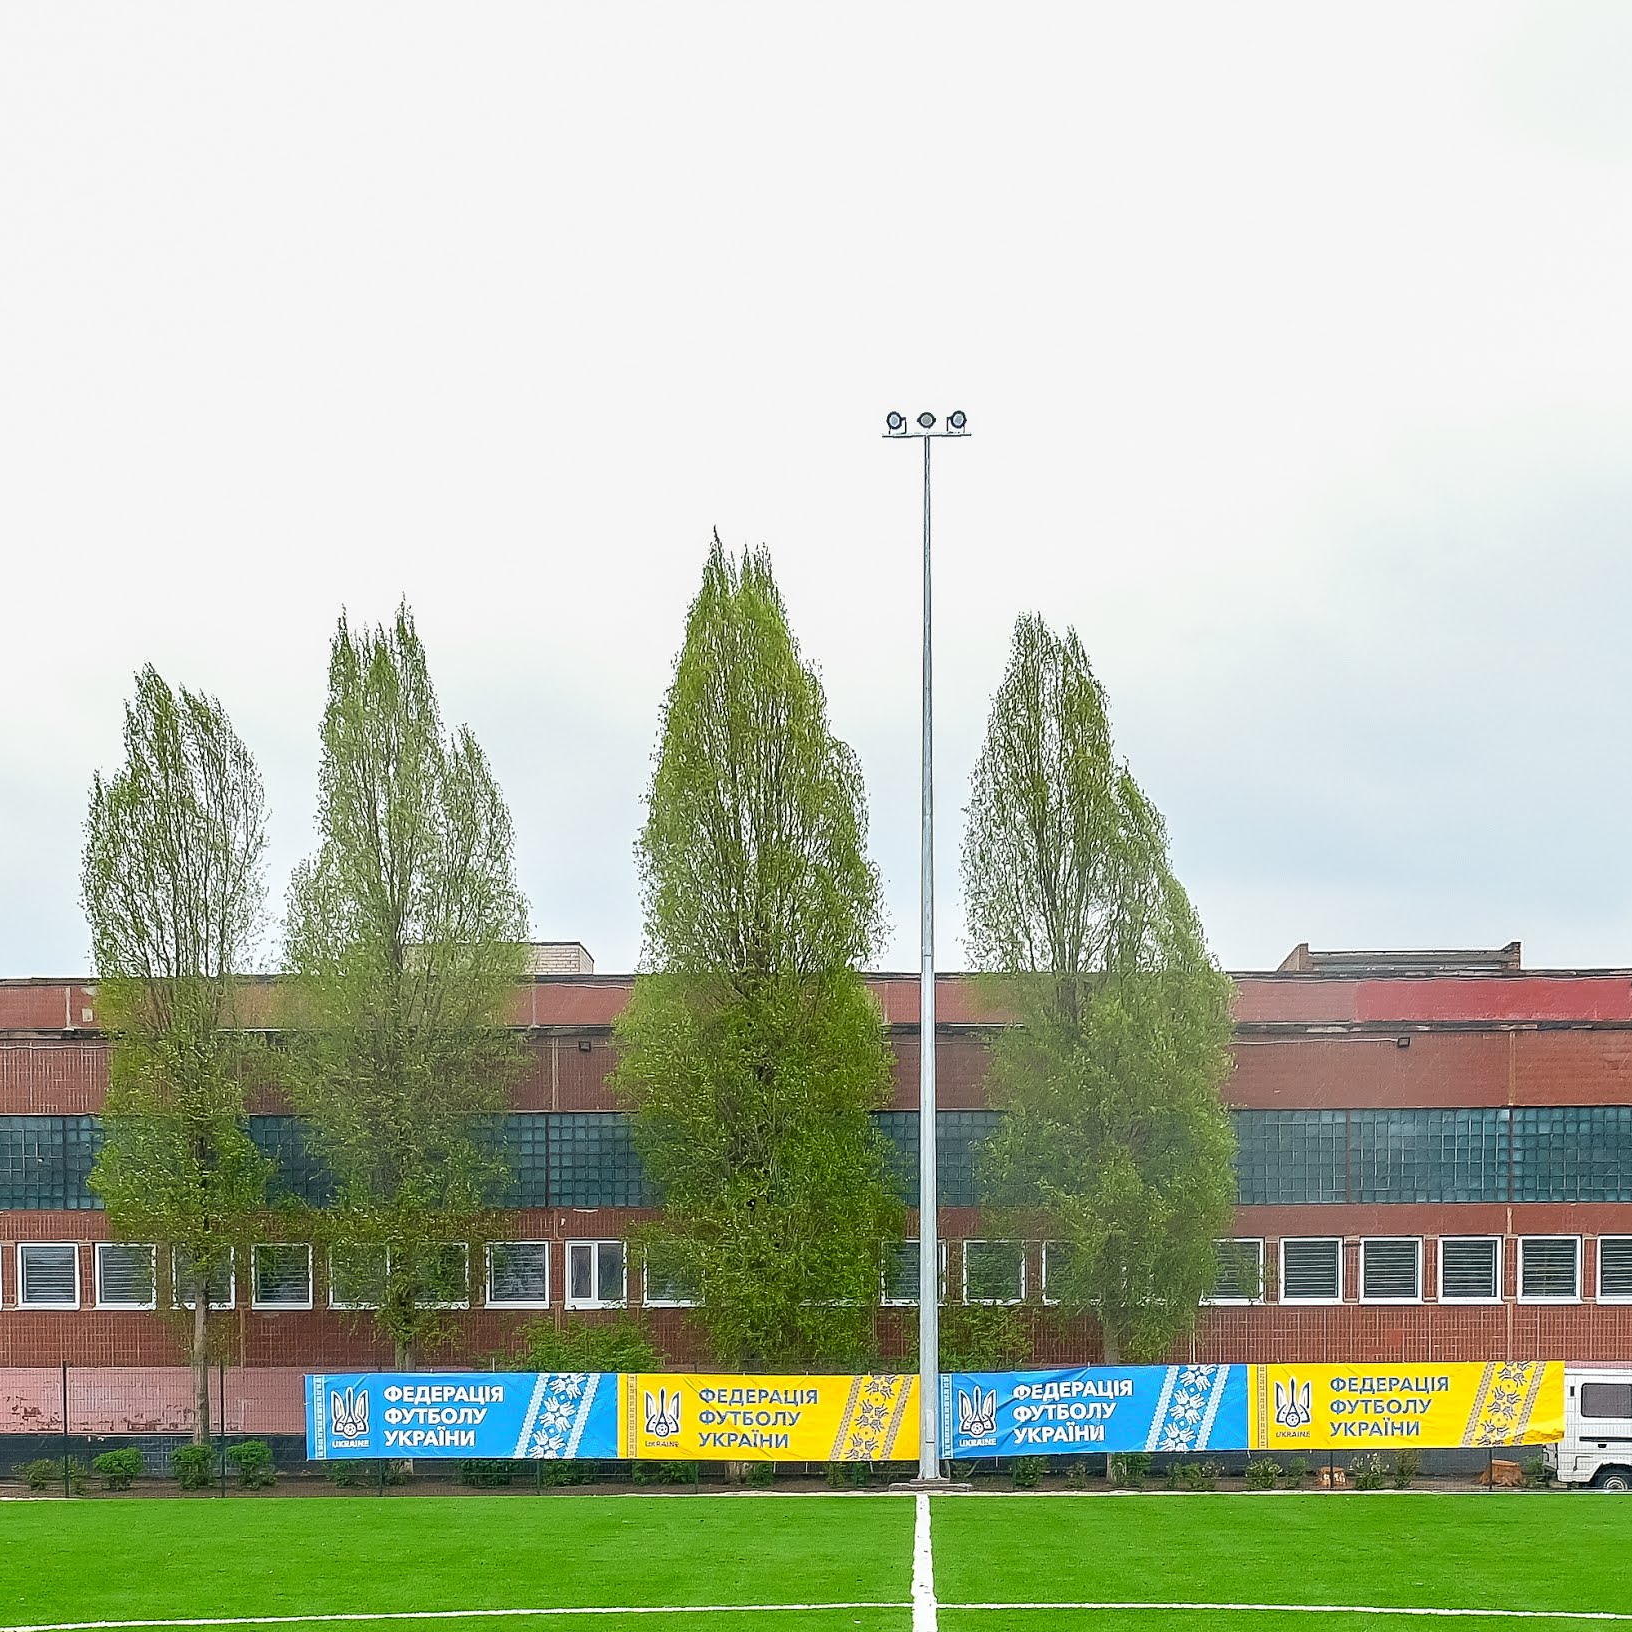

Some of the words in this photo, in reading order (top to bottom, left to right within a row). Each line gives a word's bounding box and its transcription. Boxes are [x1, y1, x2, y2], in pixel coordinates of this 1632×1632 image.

[383, 1385, 504, 1405] ФЕДЕРАЦІЯ
[1012, 1379, 1134, 1402] ФЕДЕРАЦІЯ
[1330, 1377, 1449, 1394] ФЕДЕРАЦІЯ
[698, 1388, 818, 1407] ФЕДЕРАЦІЯ
[1330, 1399, 1432, 1415] ФУТБОЛУ
[384, 1407, 488, 1424] ФУТБОЛУ
[698, 1410, 801, 1426] ФУТБОЛУ
[1012, 1402, 1117, 1422] ФУТБОЛУ
[383, 1426, 476, 1446] УКРАЇНИ
[1013, 1421, 1105, 1444] УКРАЇНИ
[1329, 1417, 1420, 1437] УКРАЇНИ
[698, 1429, 789, 1448] УКРАЇНИ
